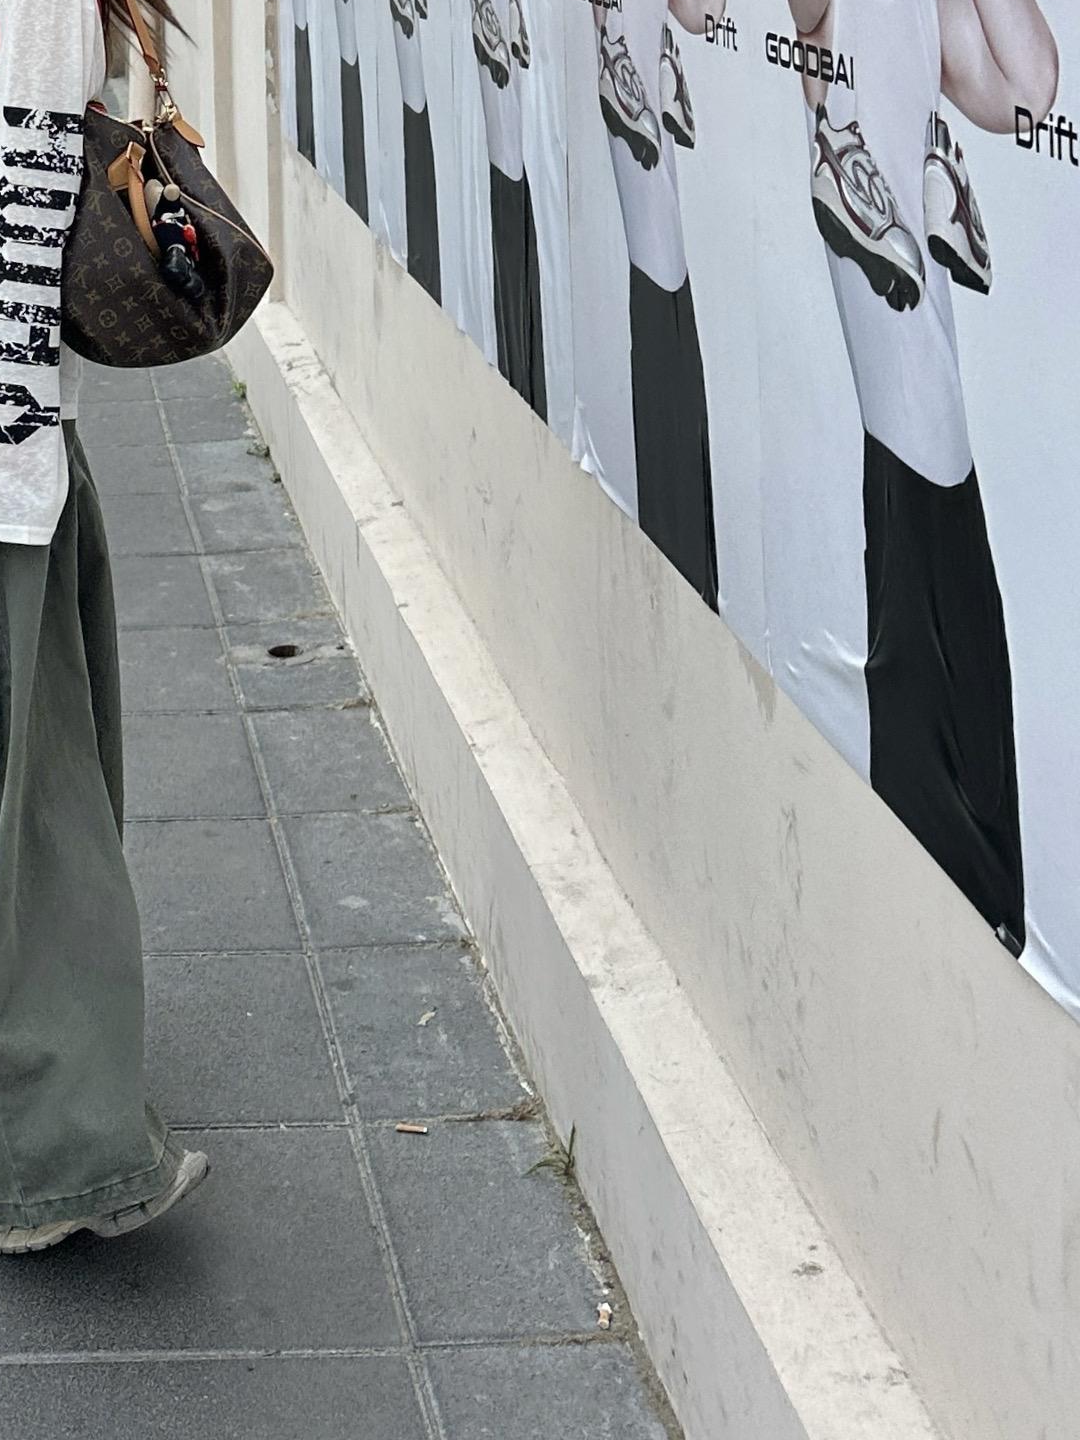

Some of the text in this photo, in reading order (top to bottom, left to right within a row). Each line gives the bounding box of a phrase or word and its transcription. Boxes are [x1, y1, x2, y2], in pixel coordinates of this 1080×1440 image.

[705, 13, 738, 51] Drift
[765, 31, 1079, 167] GOODBAI Drift
